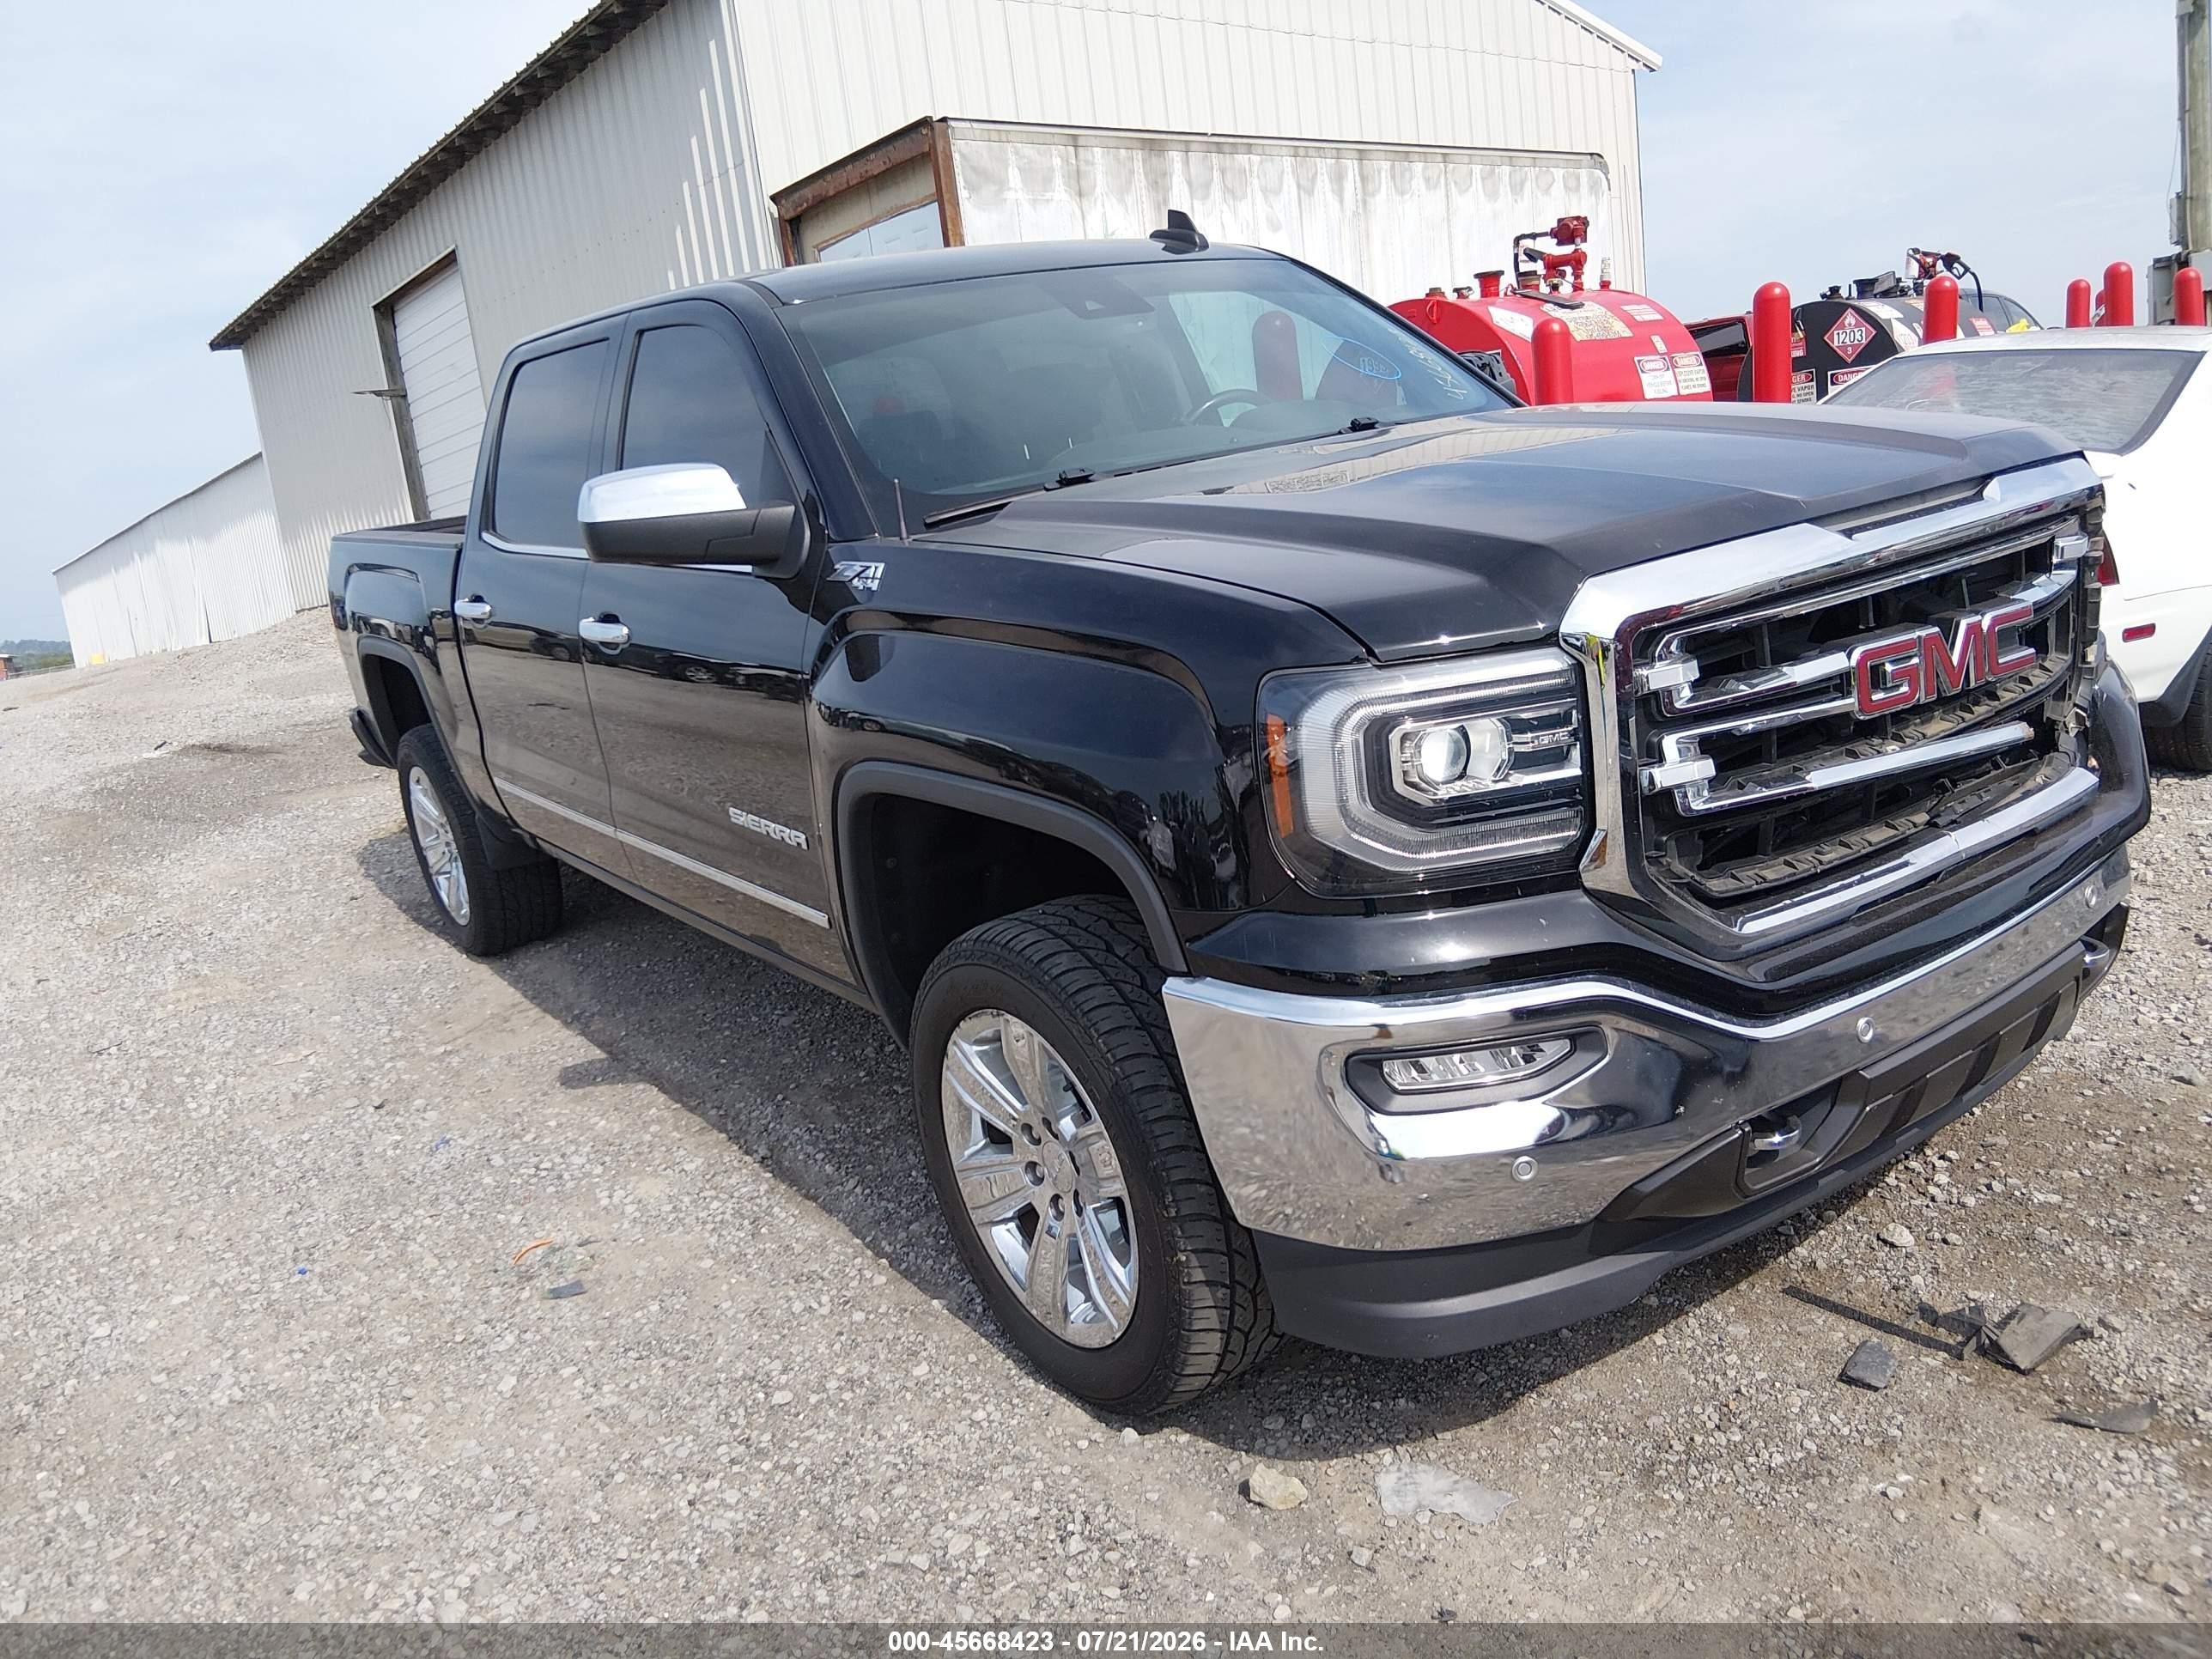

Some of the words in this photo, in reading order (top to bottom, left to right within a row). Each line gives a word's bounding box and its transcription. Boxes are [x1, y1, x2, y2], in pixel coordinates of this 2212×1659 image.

[1836, 329, 1863, 344] 1203
[826, 561, 885, 581] Z71
[1850, 603, 2036, 720] GMC
[1539, 732, 1569, 744] GMC
[729, 807, 809, 850] SIERRA
